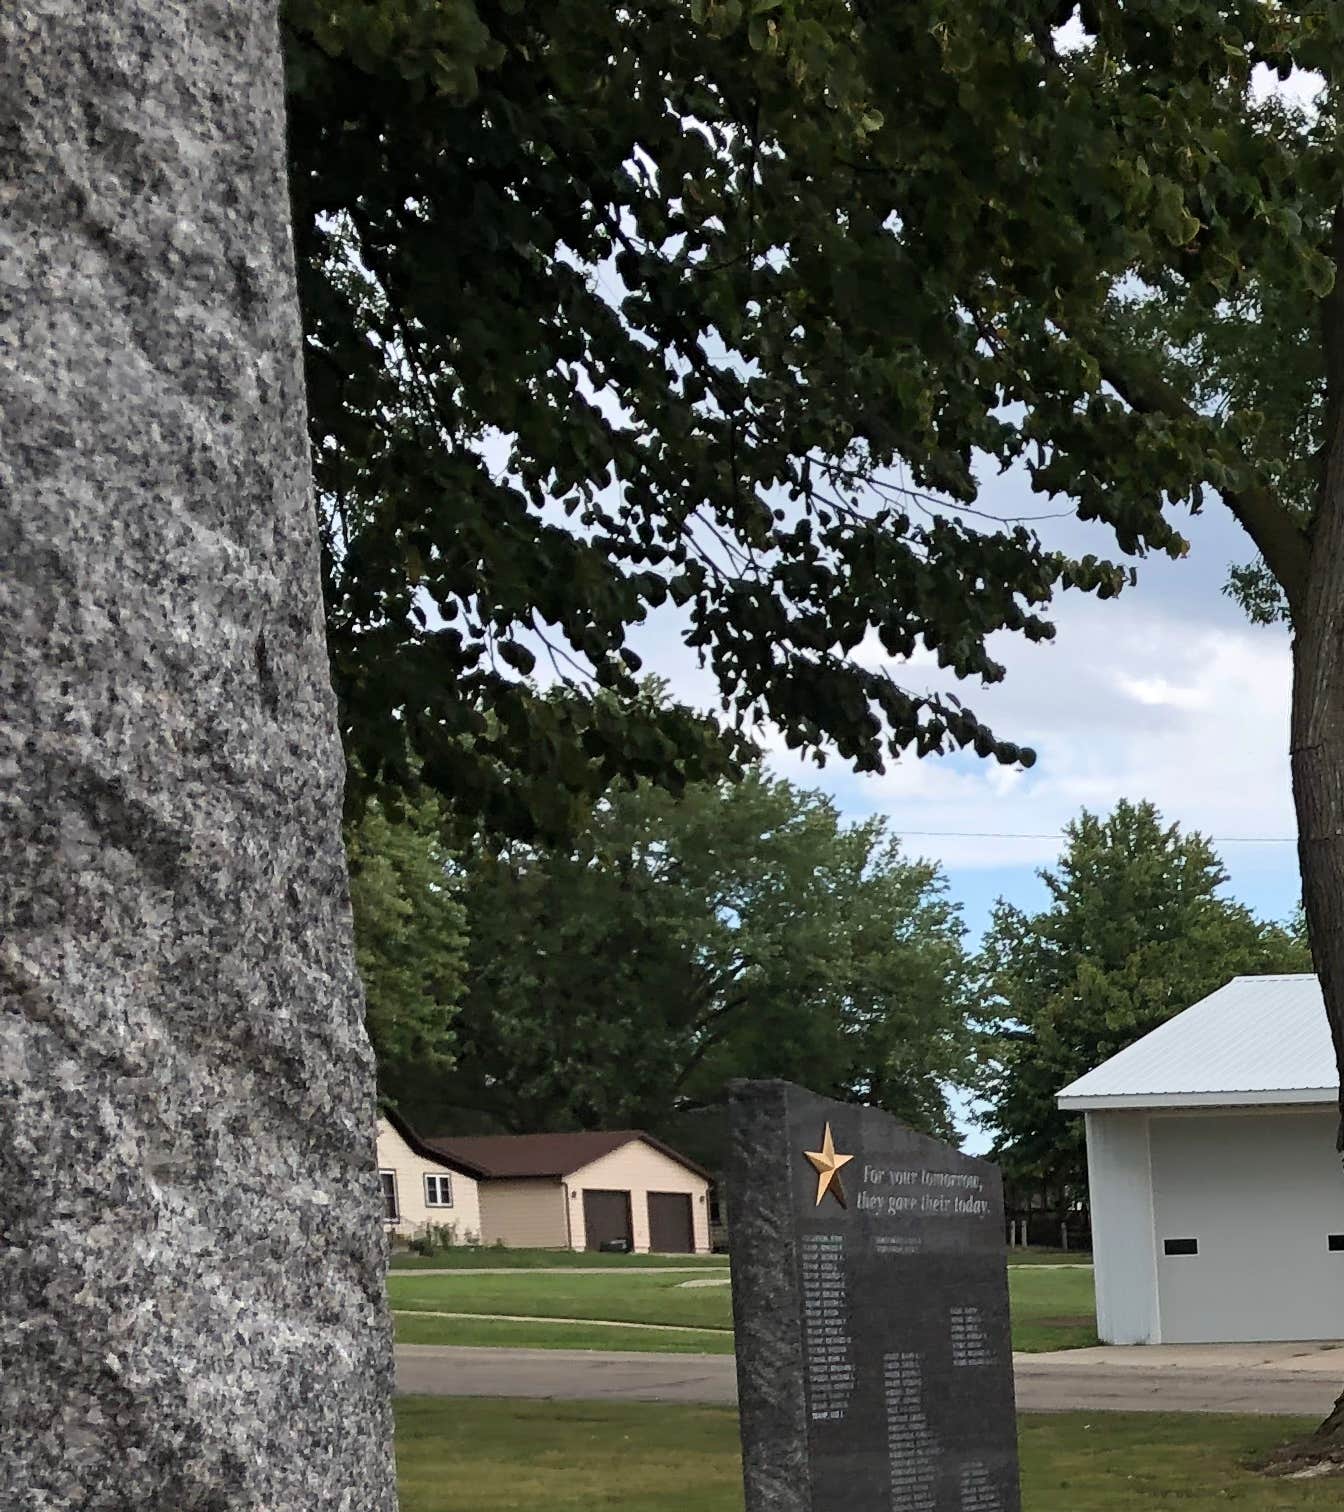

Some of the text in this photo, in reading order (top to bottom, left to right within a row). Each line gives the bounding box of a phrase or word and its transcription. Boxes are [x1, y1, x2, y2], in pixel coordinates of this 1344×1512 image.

[863, 1164, 983, 1192] For your tomorrow,
[857, 1191, 991, 1219] they gave their today.
